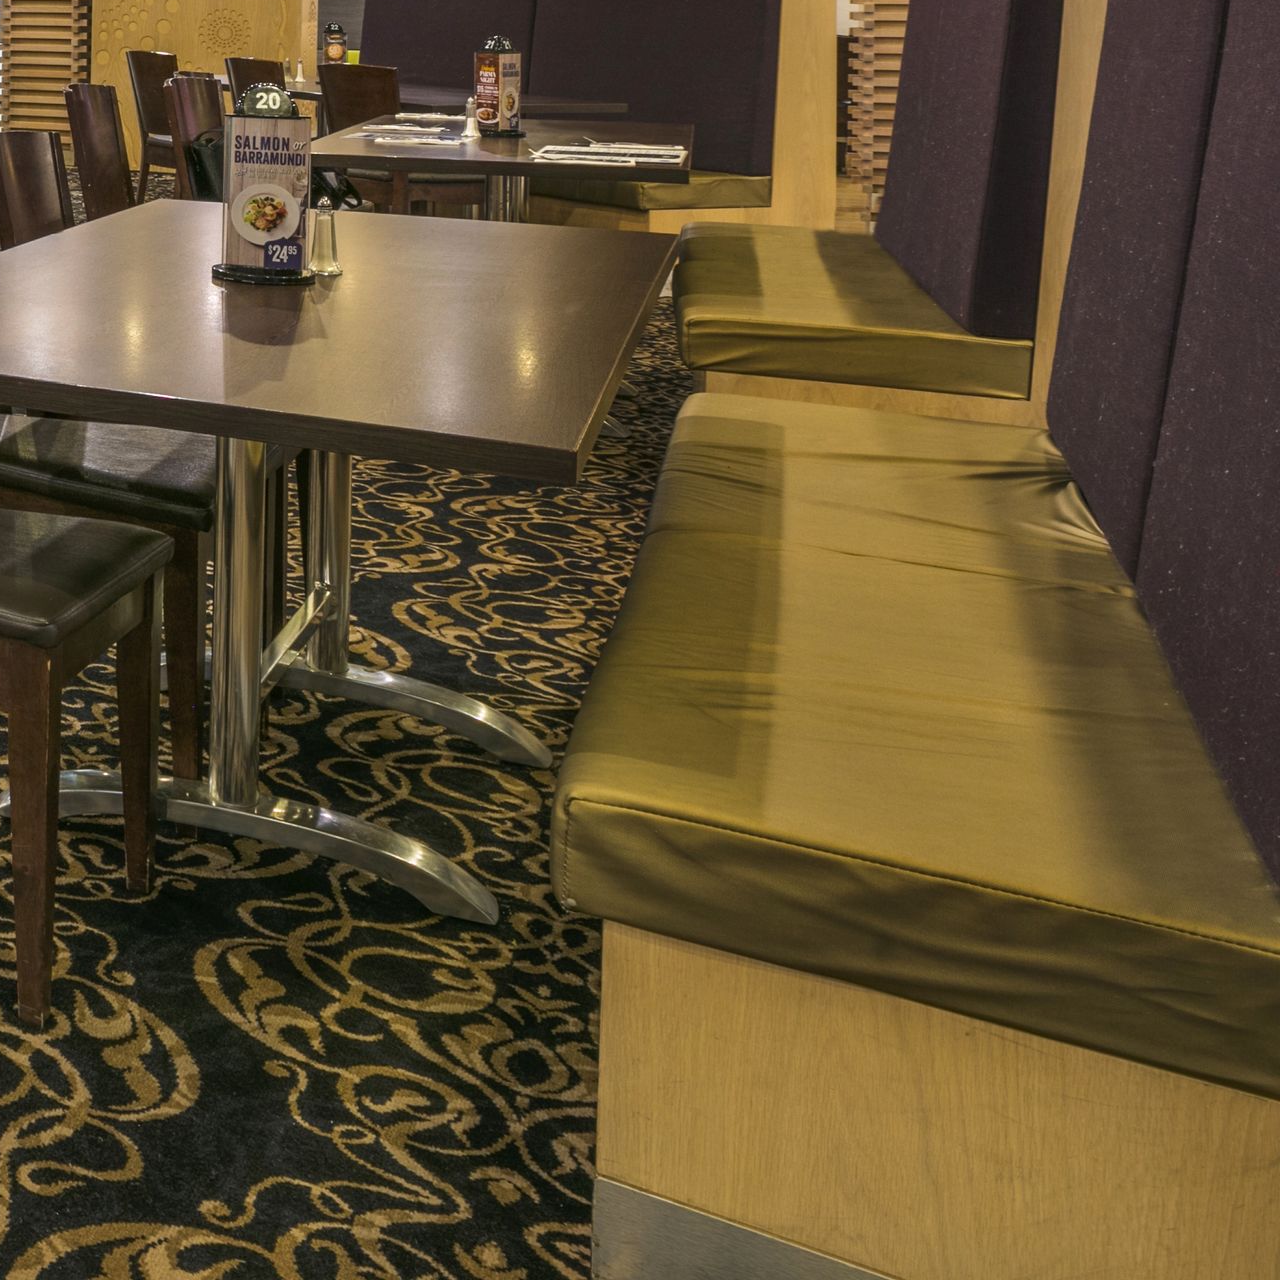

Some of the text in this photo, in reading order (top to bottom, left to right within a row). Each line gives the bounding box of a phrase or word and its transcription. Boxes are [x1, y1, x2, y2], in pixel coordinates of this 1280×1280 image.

[484, 40, 495, 49] 21
[255, 92, 281, 110] 20
[235, 135, 307, 152] SALMON or
[234, 150, 307, 166] BARRAMUNDI
